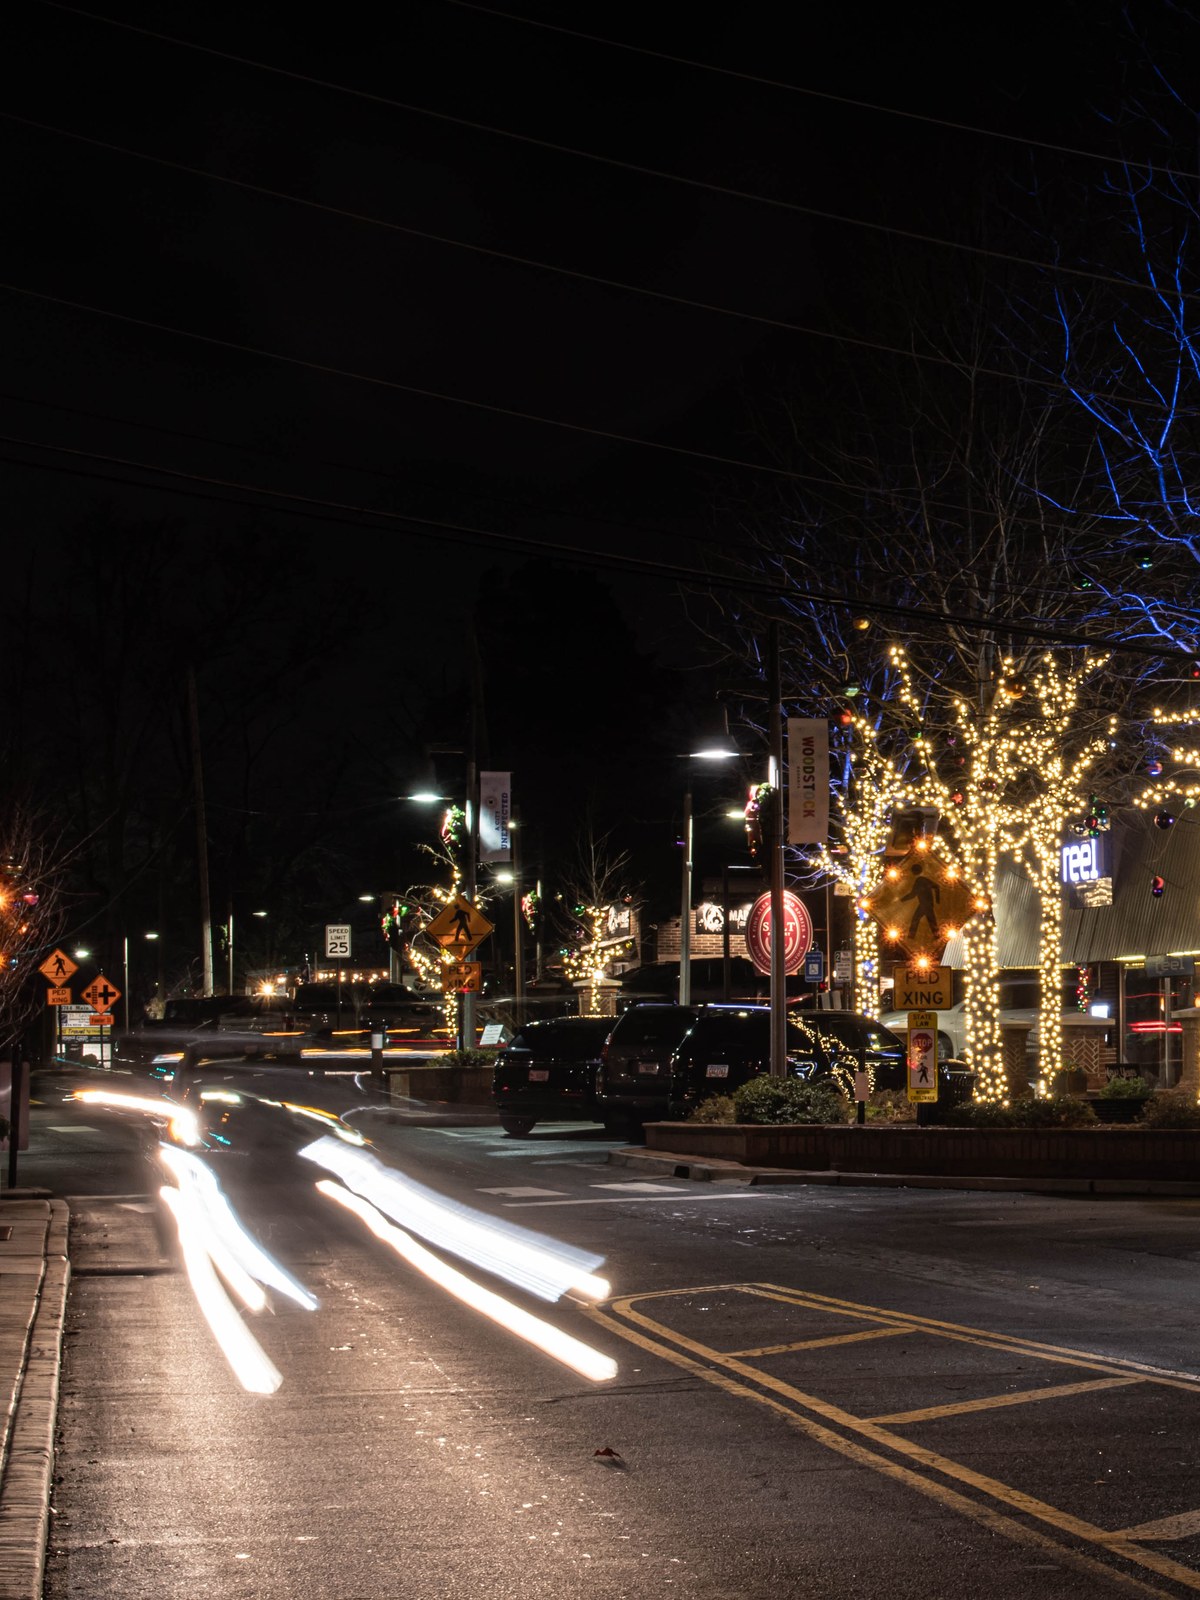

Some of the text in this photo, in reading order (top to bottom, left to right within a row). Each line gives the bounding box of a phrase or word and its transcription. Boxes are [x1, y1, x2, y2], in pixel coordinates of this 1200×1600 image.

[802, 736, 815, 818] WOODSTOCK
[1062, 838, 1099, 883] reel
[762, 922, 795, 932] ST
[329, 942, 348, 954] 25
[448, 965, 473, 975] PED
[447, 979, 475, 989] XING
[905, 971, 940, 985] PED
[903, 991, 944, 1005] XING
[912, 1038, 932, 1047] STOP
